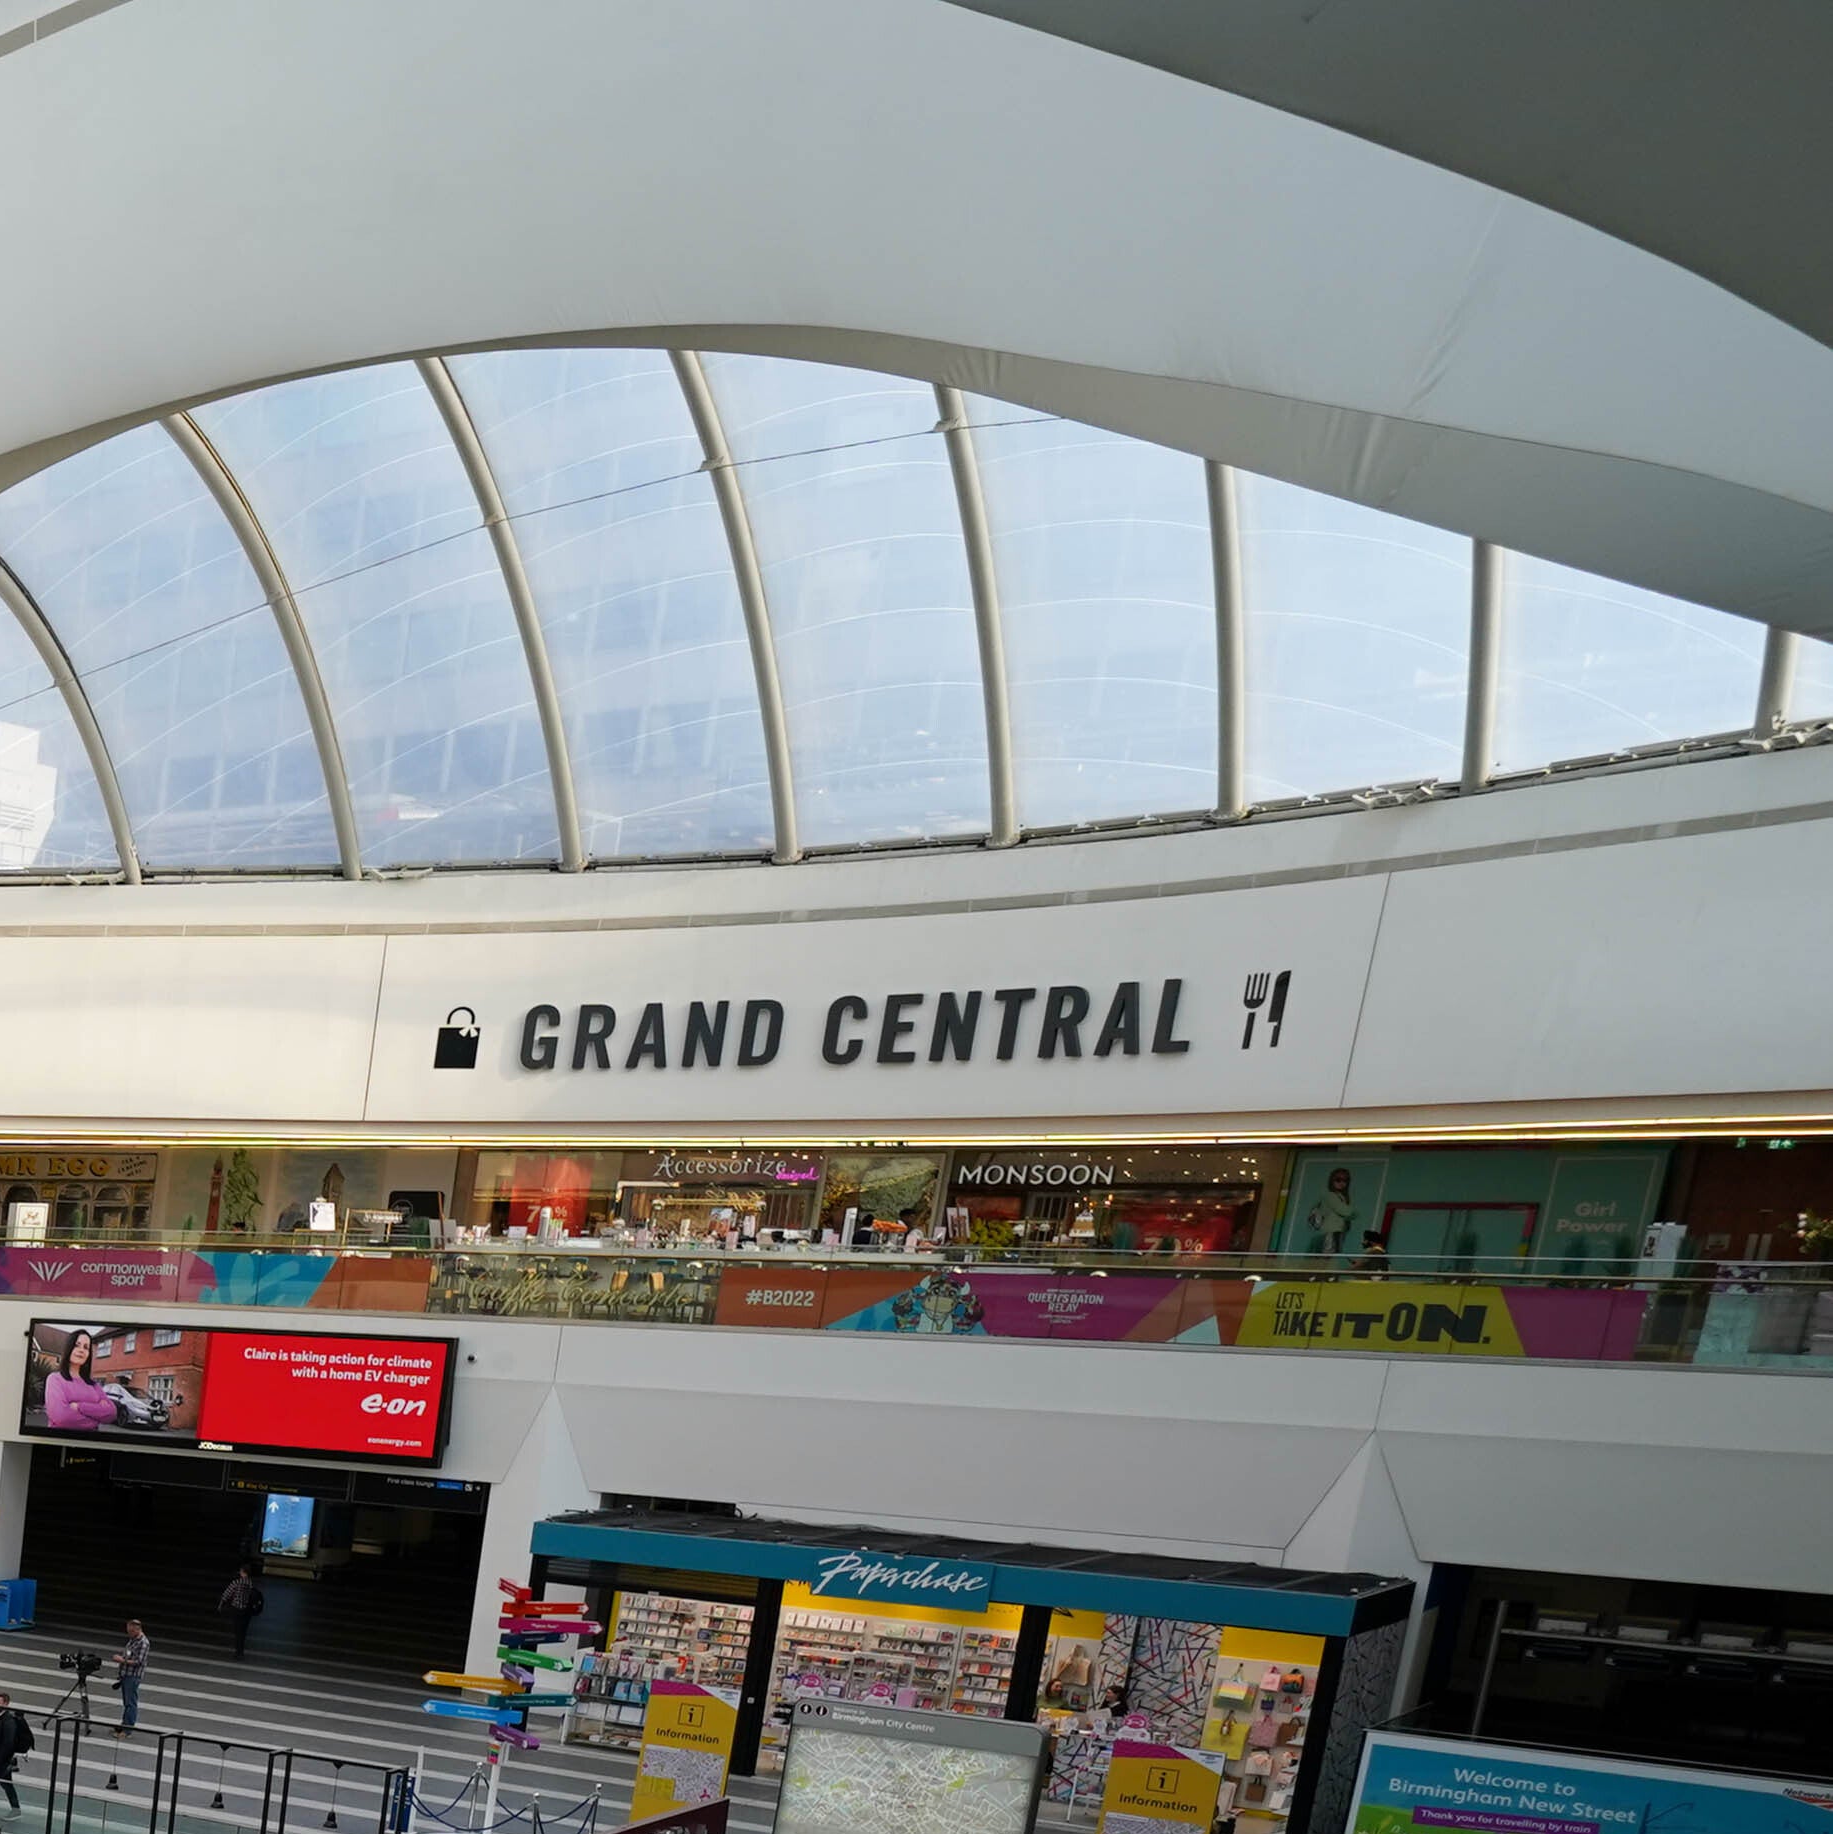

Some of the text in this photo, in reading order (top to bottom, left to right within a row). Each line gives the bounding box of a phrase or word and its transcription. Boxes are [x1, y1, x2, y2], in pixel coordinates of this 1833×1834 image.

[518, 977, 1191, 1072] GRAND CENTRAL
[47, 1156, 110, 1177] EGG
[653, 1154, 788, 1178] Accessorize
[958, 1164, 1114, 1186] MONSOON
[1574, 1201, 1616, 1217] Girl
[1555, 1219, 1627, 1234] Power
[80, 1261, 179, 1277] commonwealth
[110, 1273, 145, 1287] sport
[745, 1288, 815, 1307] #B2022
[1047, 1301, 1078, 1313] RELAY
[1069, 1293, 1105, 1306] BATON
[1276, 1291, 1305, 1310] LET'S
[1272, 1301, 1492, 1346] TAKE IT ON.
[244, 1347, 432, 1369] Claire is taking action for climate
[291, 1366, 430, 1387] with a home EV charger
[811, 1551, 989, 1595] Paperchase
[832, 1711, 935, 1733] Birmingham City Centre
[656, 1727, 720, 1745] Information
[1453, 1768, 1576, 1797] Welcome to
[1118, 1792, 1198, 1813] Information
[1388, 1777, 1637, 1825] Birmingham New Street
[1420, 1809, 1592, 1834] Thank you for travelling by train
